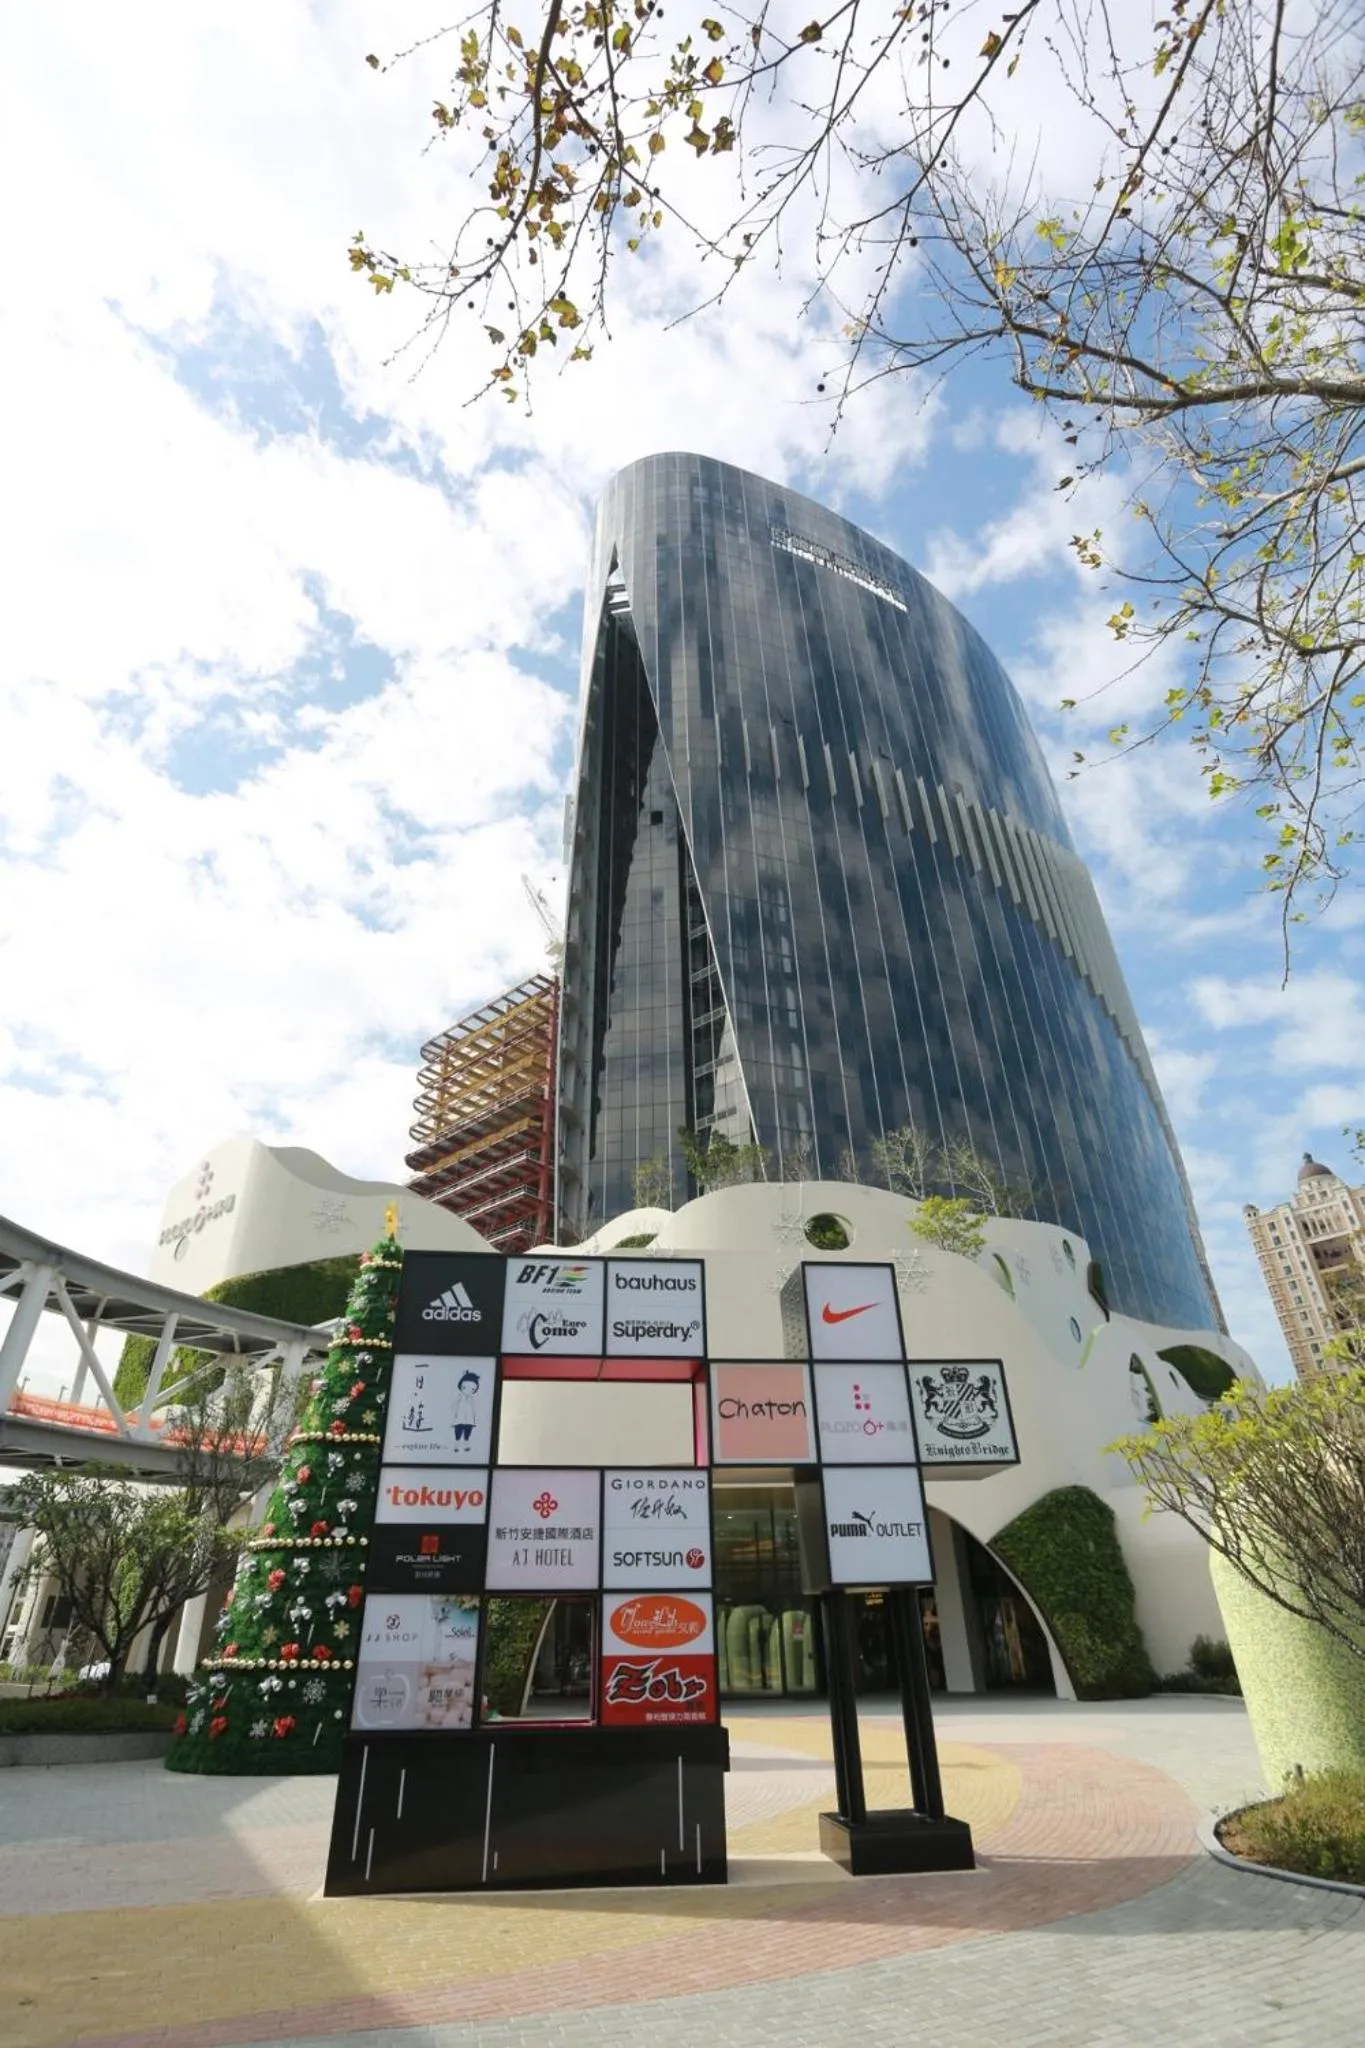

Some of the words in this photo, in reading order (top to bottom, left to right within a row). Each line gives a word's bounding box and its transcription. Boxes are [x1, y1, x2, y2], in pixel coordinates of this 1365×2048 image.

[516, 1264, 560, 1285] BF1
[615, 1273, 697, 1291] bauhaus
[421, 1306, 482, 1322] adidas
[529, 1313, 579, 1350] Como
[562, 1319, 587, 1329] Euro
[718, 1397, 807, 1420] Chaton
[611, 1479, 706, 1491] GIORDANO
[386, 1486, 484, 1510] tokuyo
[495, 1527, 594, 1541] 新竹安捷國際酒店
[831, 1523, 867, 1537] PUMA
[876, 1523, 921, 1537] OUTLET
[535, 1548, 574, 1567] HOTEL
